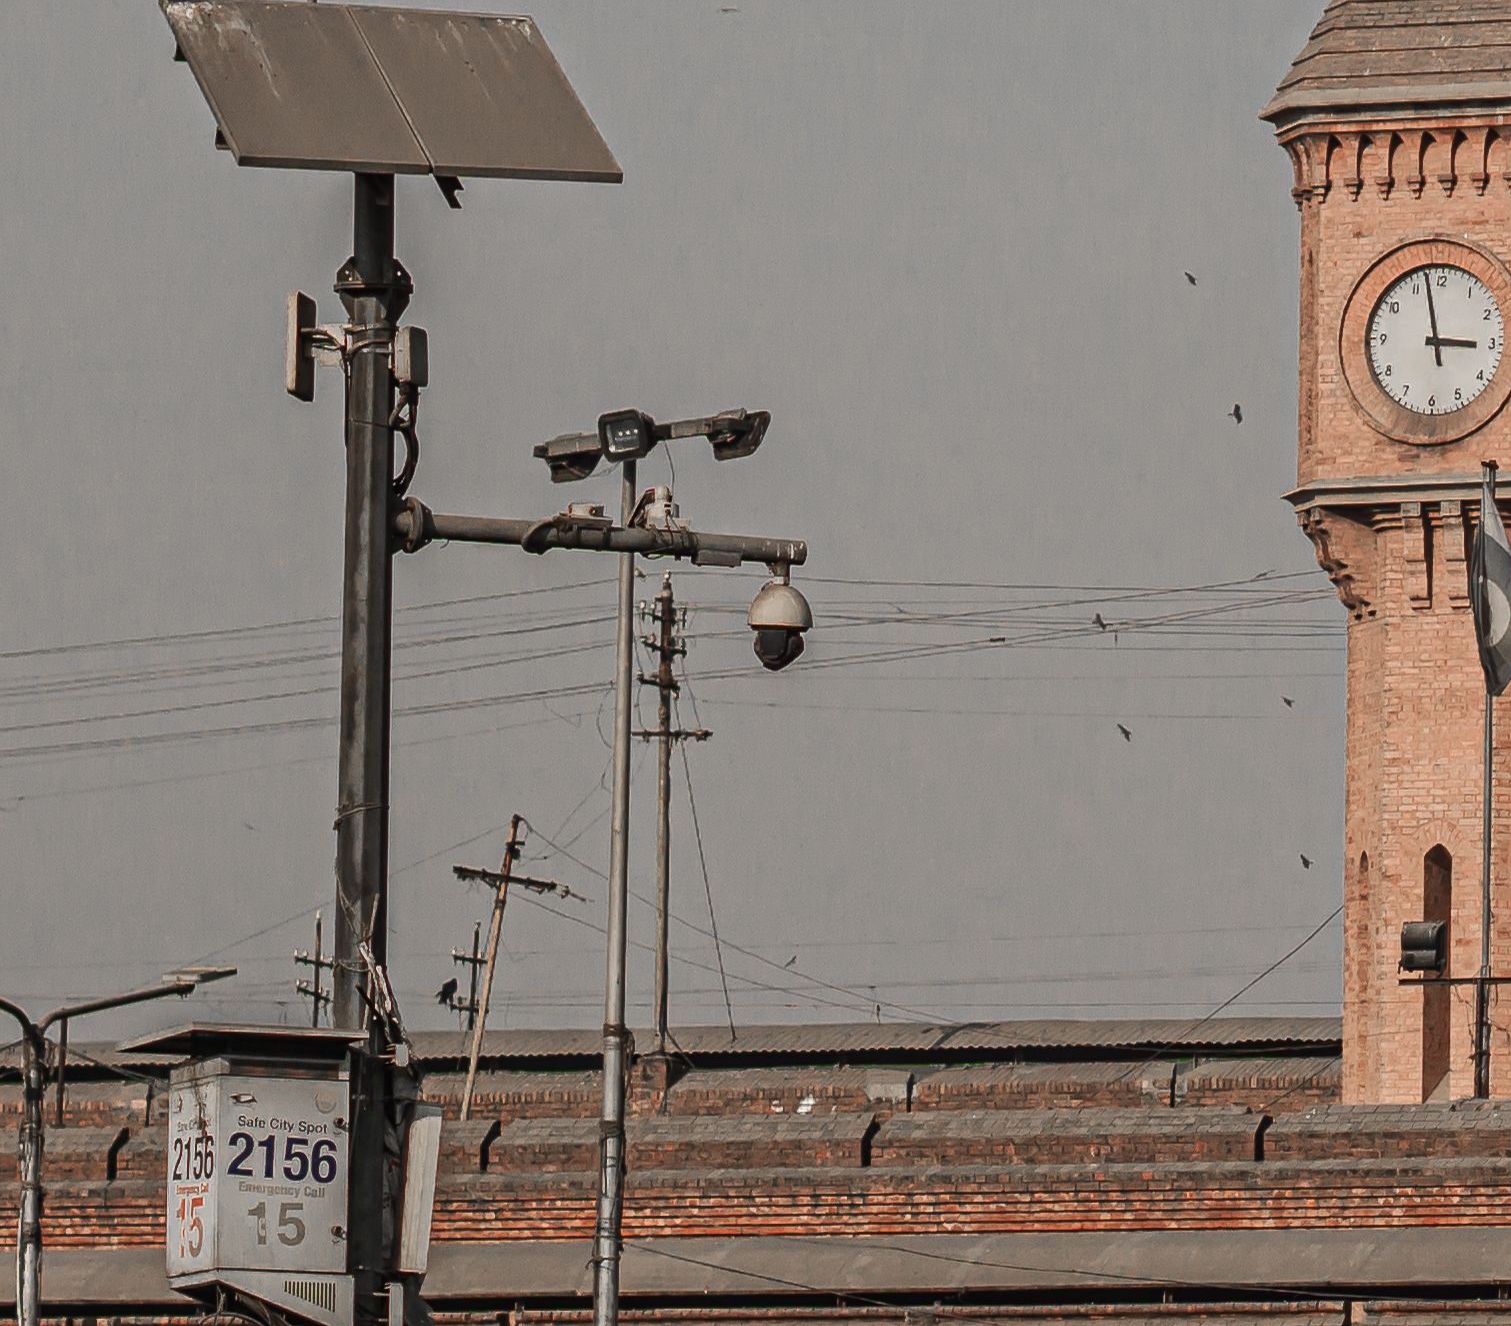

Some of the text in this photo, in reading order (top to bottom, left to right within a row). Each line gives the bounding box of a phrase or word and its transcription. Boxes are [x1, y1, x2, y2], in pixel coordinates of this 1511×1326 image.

[1436, 276, 1447, 288] 12
[1412, 283, 1420, 295] 11
[1388, 301, 1399, 314] 10
[1483, 309, 1491, 321] 2
[1380, 334, 1387, 345] 9
[1488, 338, 1496, 350] 3
[1385, 365, 1392, 376] 8
[1476, 370, 1484, 380] 4
[1403, 385, 1409, 397] 7
[1454, 388, 1462, 400] 5
[1428, 395, 1436, 407] 6
[238, 1115, 328, 1134] Safe City Spot
[172, 1135, 215, 1181] 2156
[226, 1132, 338, 1184] 2156
[238, 1181, 325, 1199] Emergency Call
[247, 1202, 306, 1247] 15
